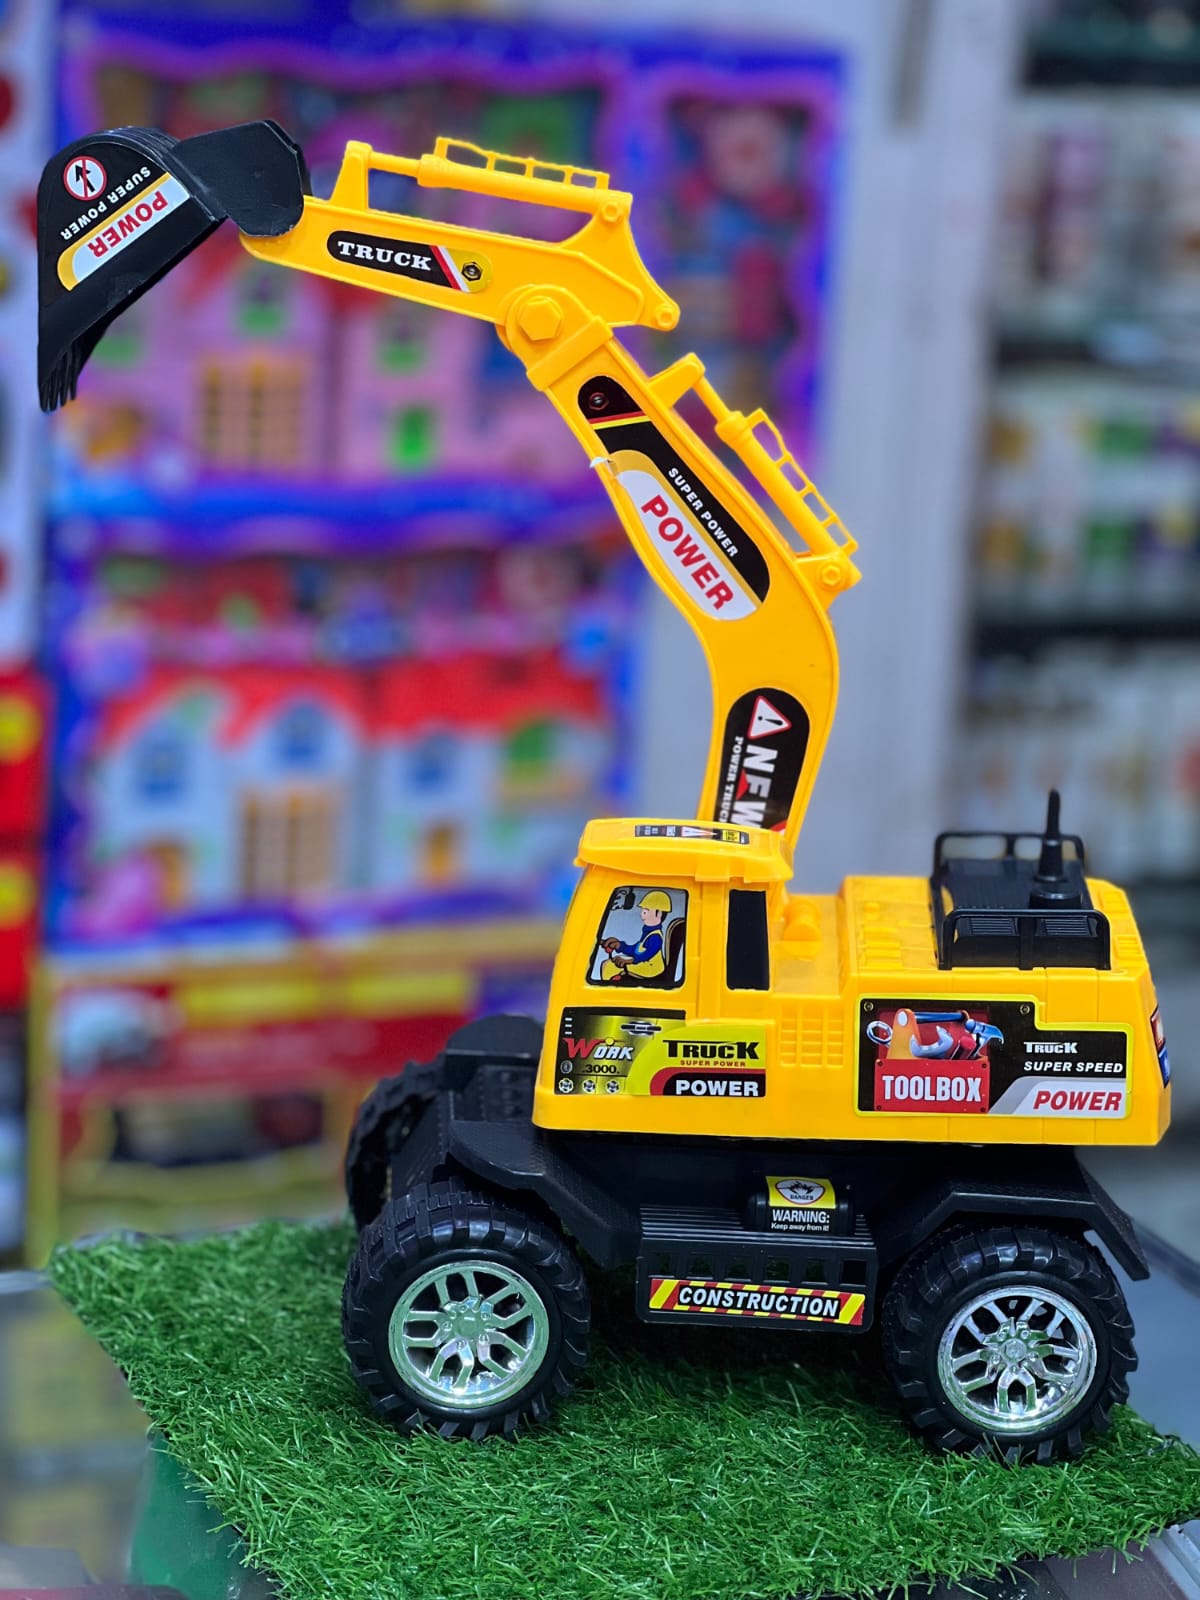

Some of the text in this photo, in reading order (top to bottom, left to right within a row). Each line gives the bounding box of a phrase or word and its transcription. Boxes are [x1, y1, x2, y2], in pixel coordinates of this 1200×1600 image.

[60, 166, 151, 240] SUPER POWER
[87, 190, 169, 258] POWER
[337, 240, 432, 271] TRUCK
[668, 467, 739, 557] SUPER POWER
[640, 494, 734, 610] POWER
[726, 736, 744, 782] POWER
[562, 1037, 634, 1060] WORK
[662, 1040, 760, 1059] TRUCK
[1023, 1041, 1078, 1054] TRUCK
[1023, 1061, 1124, 1073] SUPER SPEED
[675, 1079, 759, 1097] POWER
[882, 1075, 982, 1102] TOOLBOX
[1033, 1090, 1123, 1111] POWER
[771, 1222, 789, 1231] Keep
[772, 1209, 830, 1224] WARNING:
[679, 1287, 839, 1317] CONSTRUCTION
